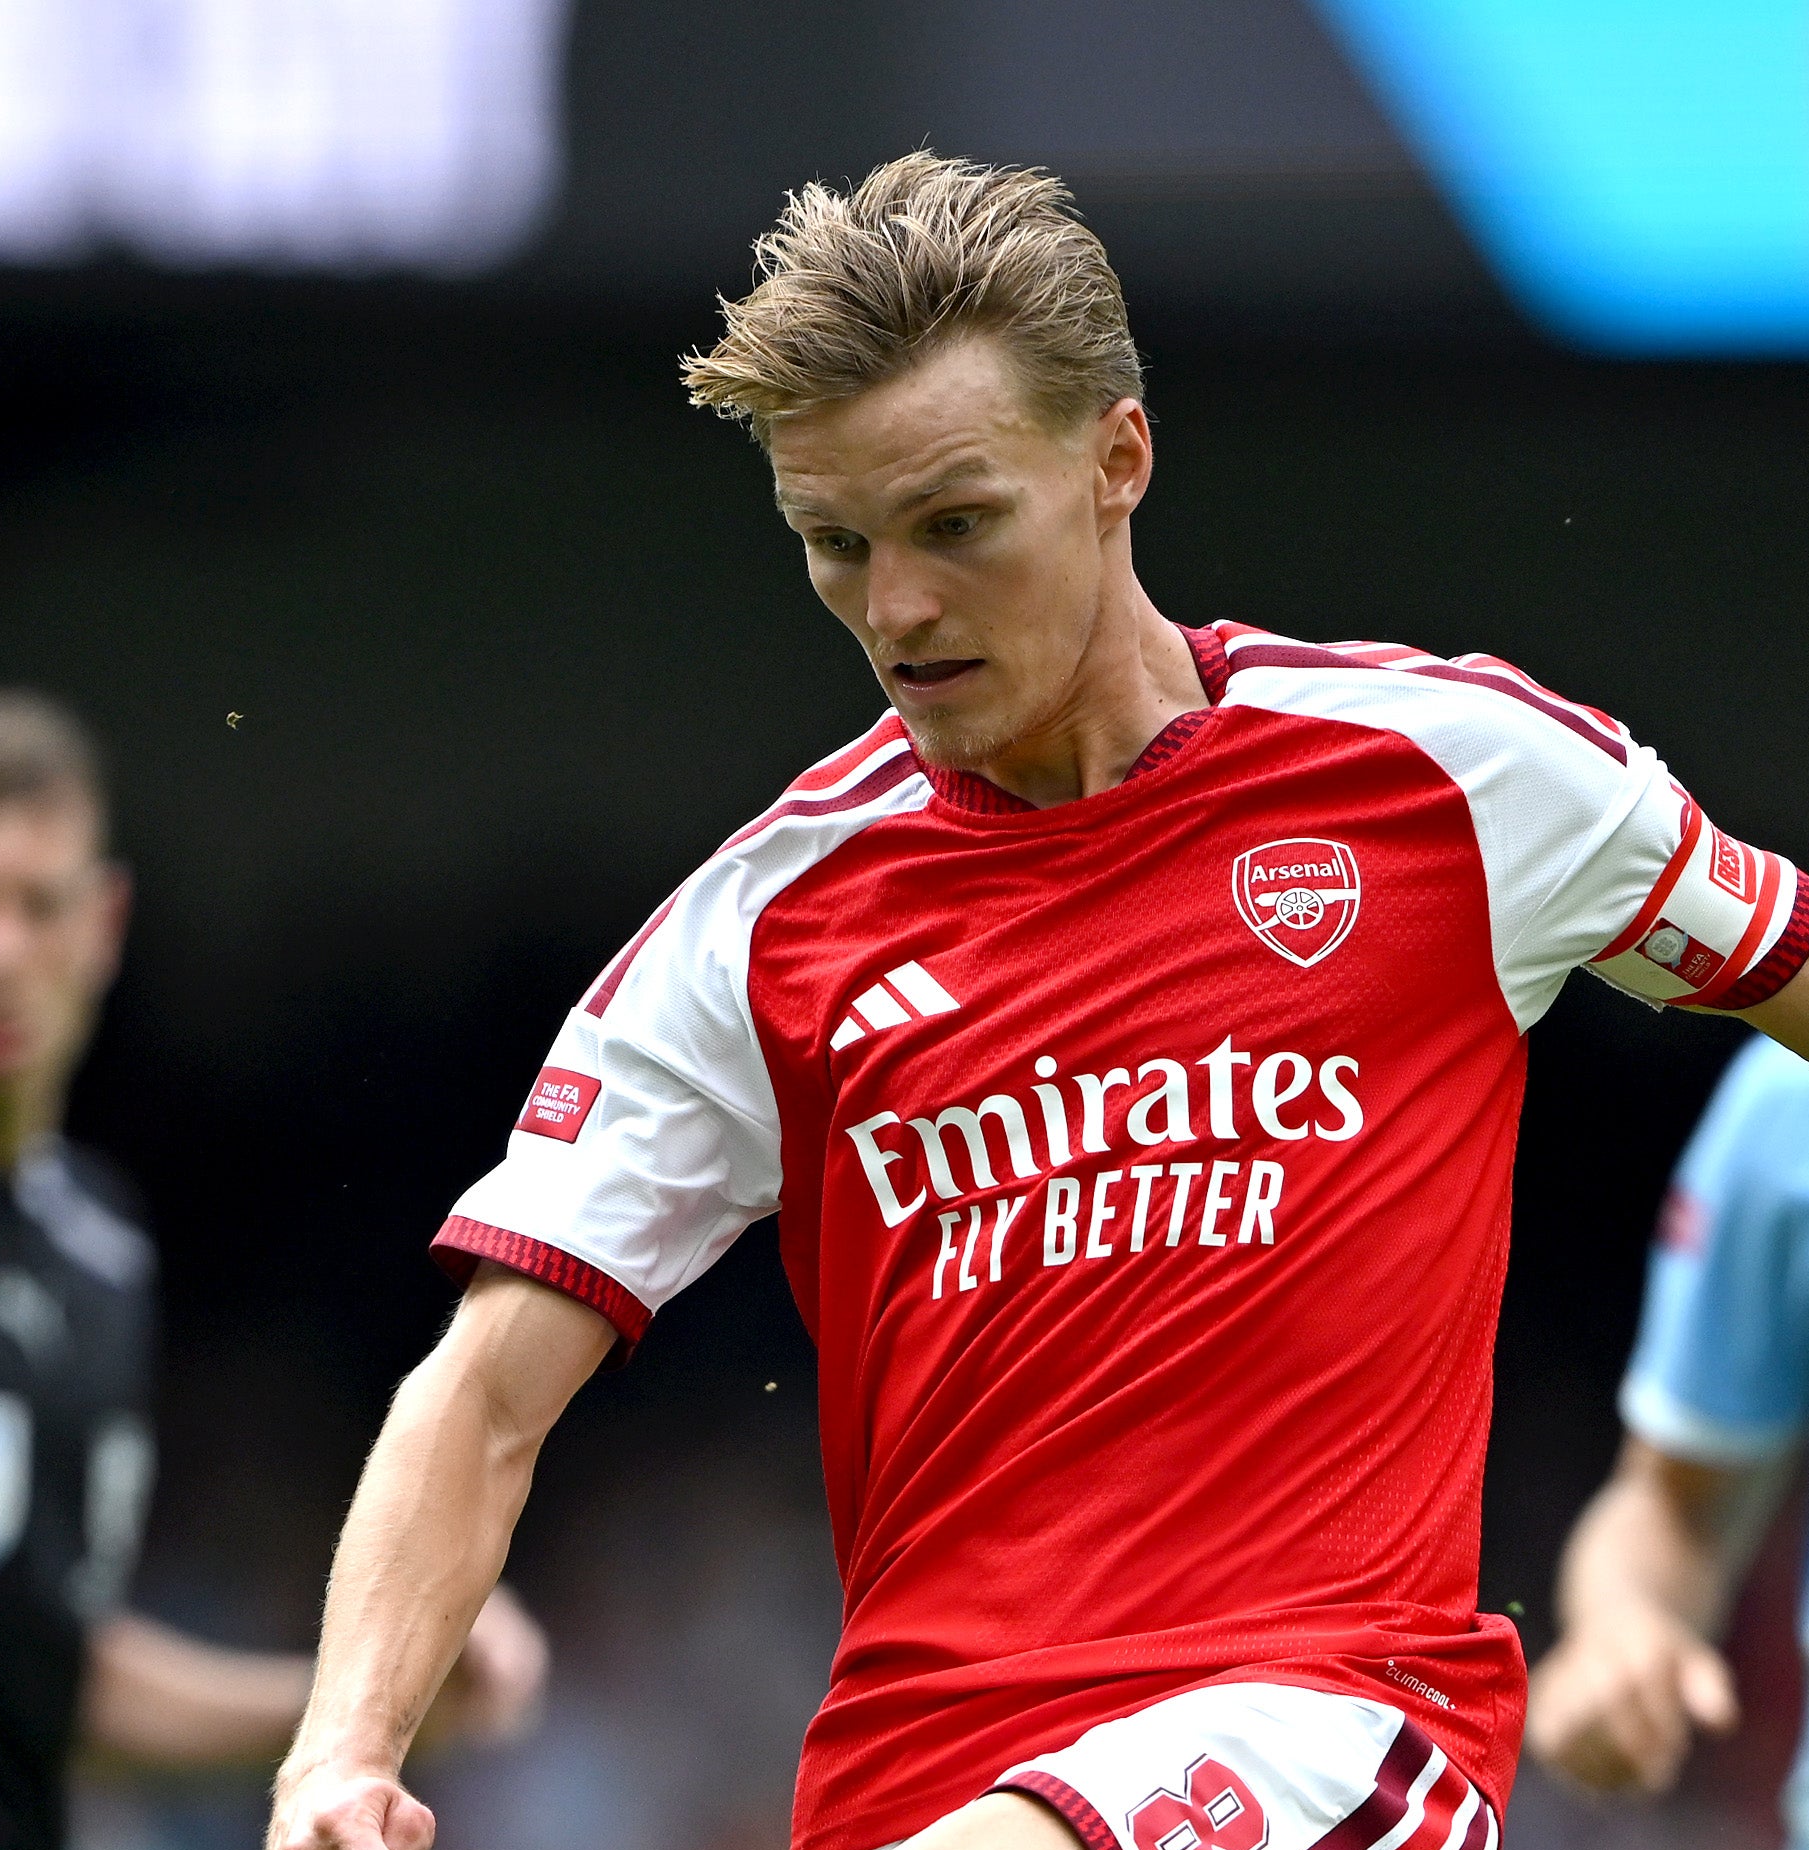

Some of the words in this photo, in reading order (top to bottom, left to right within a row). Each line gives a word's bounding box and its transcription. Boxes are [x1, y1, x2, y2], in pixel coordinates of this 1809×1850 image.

[1250, 858, 1341, 884] Arsenal
[1691, 953, 1705, 966] FA
[540, 1082, 560, 1098] THE
[559, 1083, 580, 1104] FA
[532, 1095, 581, 1115] COMMUNITY
[535, 1107, 565, 1123] SHIELD
[845, 1033, 1366, 1229] Emirates
[932, 1196, 1027, 1300] FLY
[1042, 1159, 1286, 1268] BETTER
